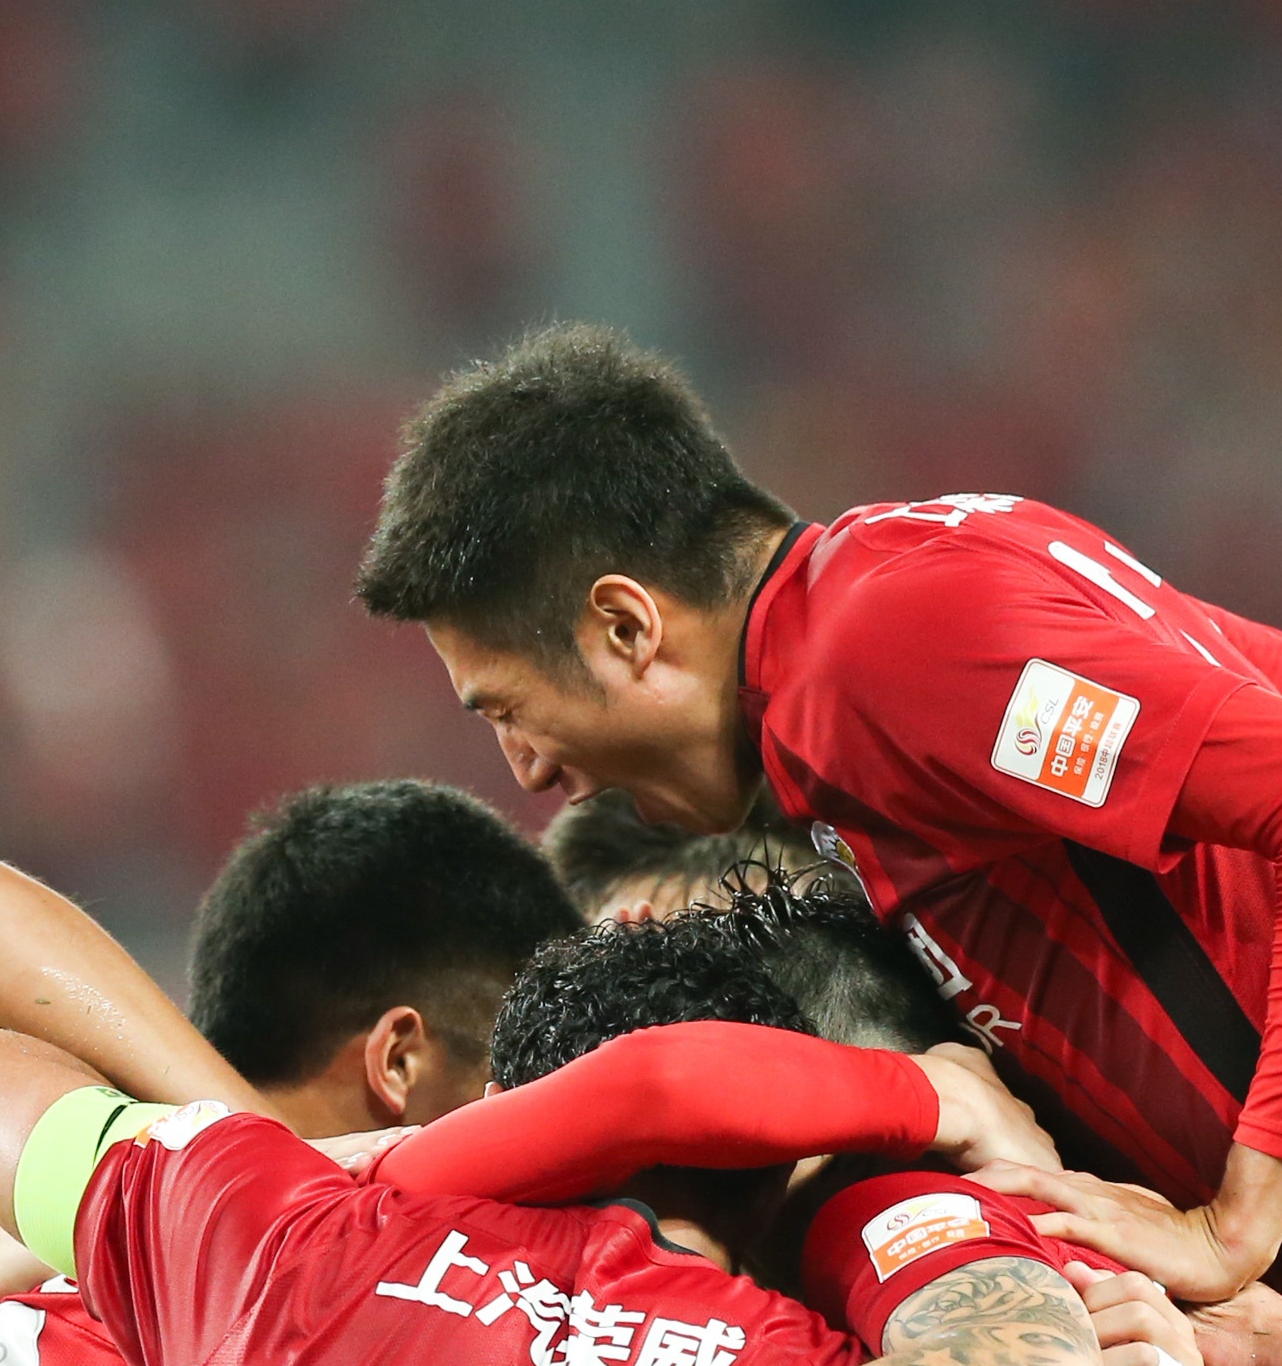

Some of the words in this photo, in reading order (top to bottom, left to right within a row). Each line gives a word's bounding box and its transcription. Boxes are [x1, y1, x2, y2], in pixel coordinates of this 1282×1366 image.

[1040, 698, 1060, 725] CSL
[1050, 695, 1095, 777] 中国平安
